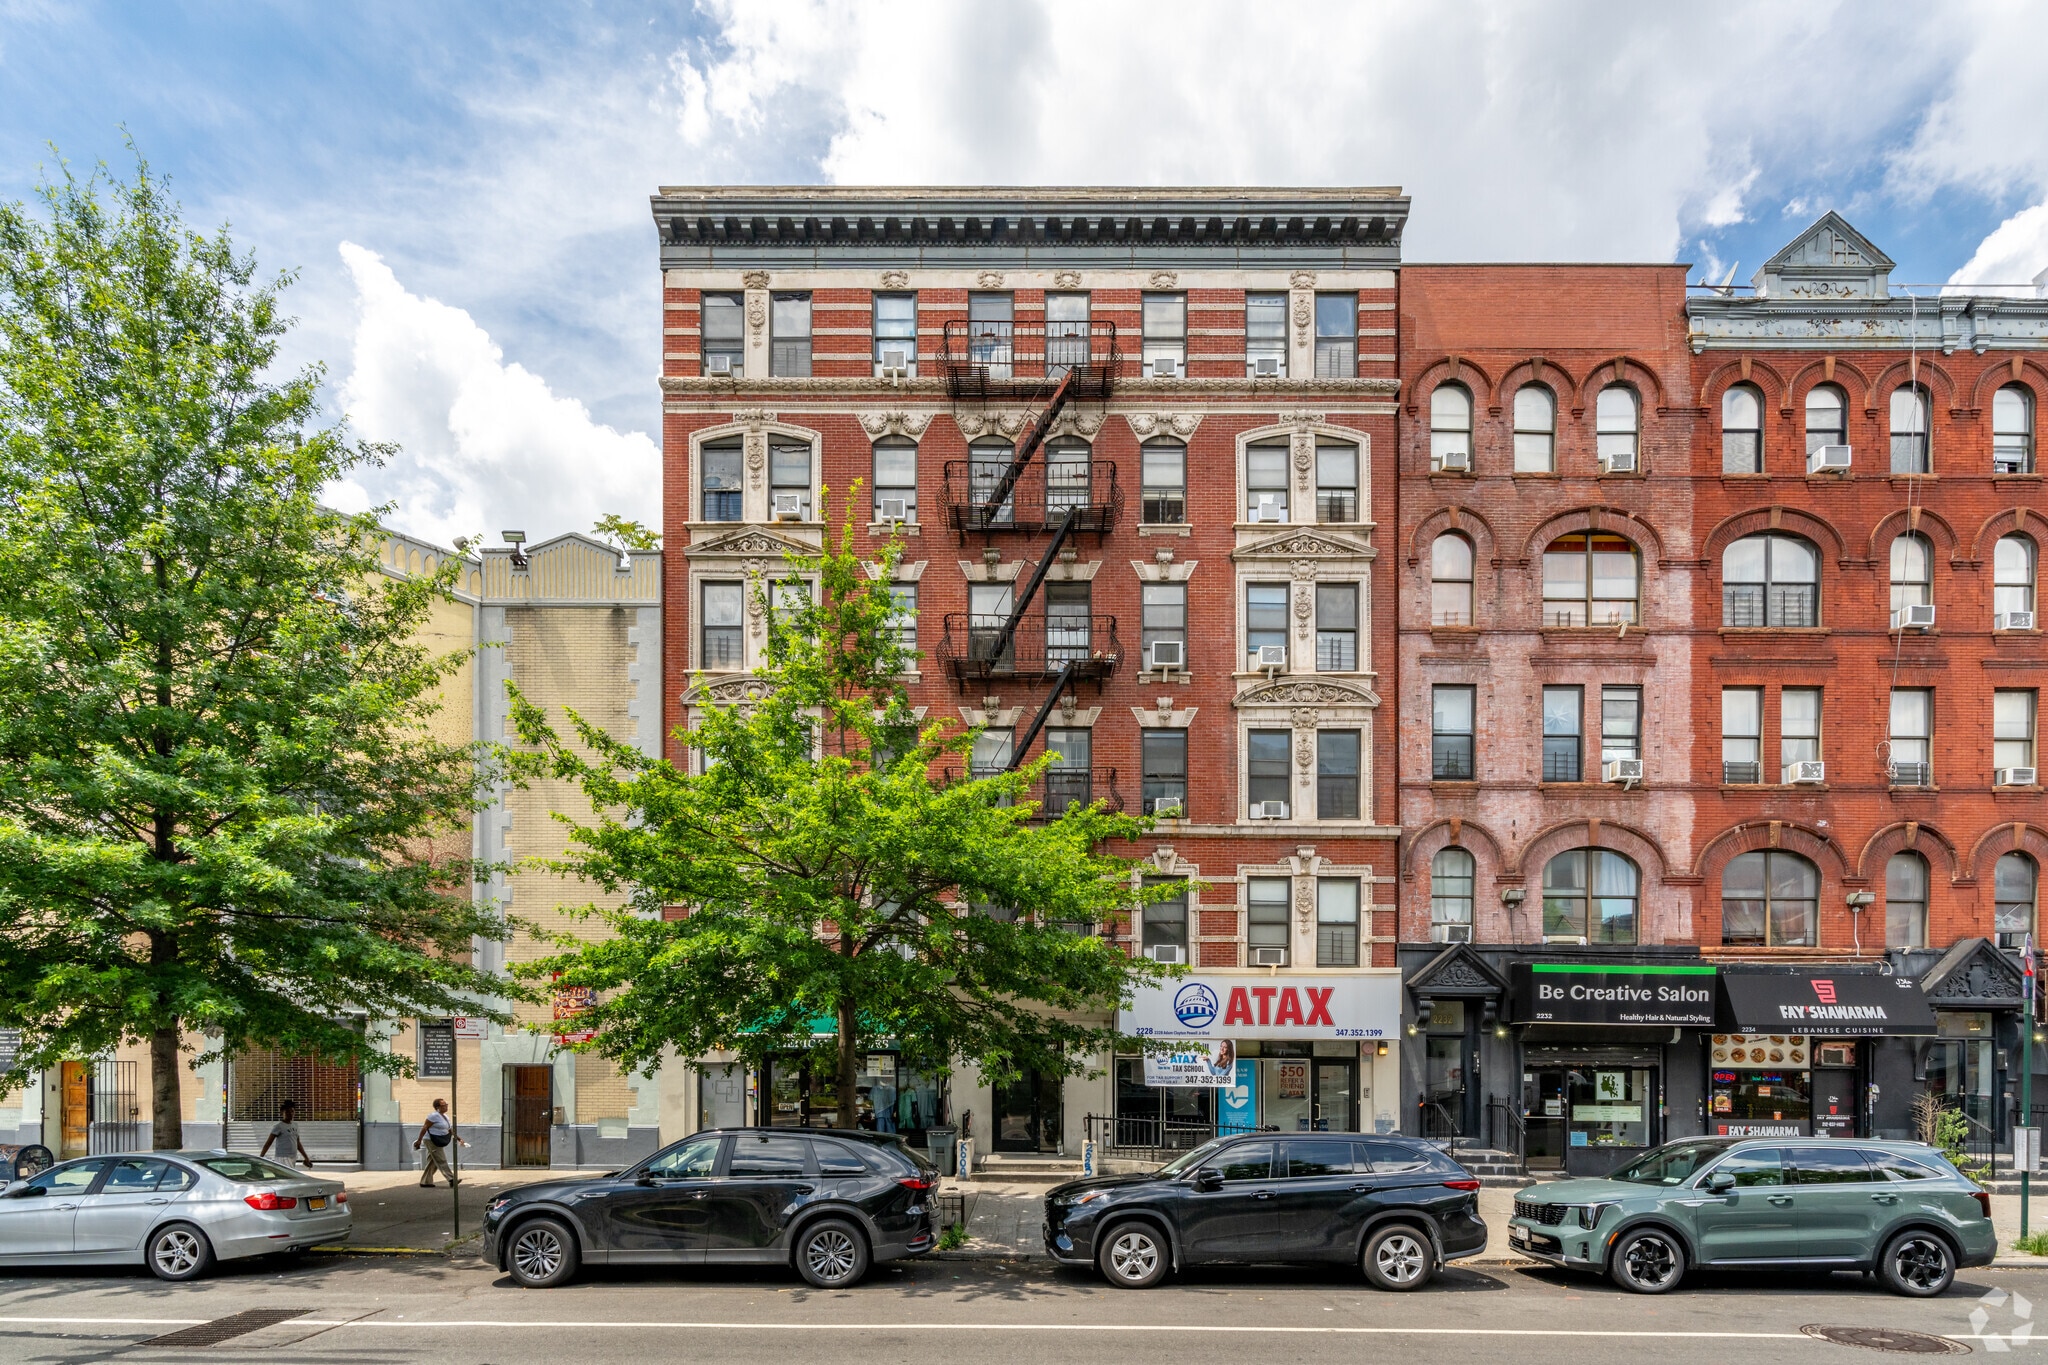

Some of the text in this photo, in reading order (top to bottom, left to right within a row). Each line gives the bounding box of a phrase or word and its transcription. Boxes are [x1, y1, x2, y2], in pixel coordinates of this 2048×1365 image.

[1539, 984, 1710, 1002] Be Creative Salon
[1222, 986, 1336, 1027] ATAX
[1620, 1013, 1645, 1022] Healthy
[1689, 1014, 1711, 1023] Styling
[1170, 1055, 1198, 1064] ATAX
[1280, 1065, 1304, 1078] $50
[1185, 1076, 1232, 1084] 347-352-1399
[1713, 1073, 1736, 1081] OPEN
